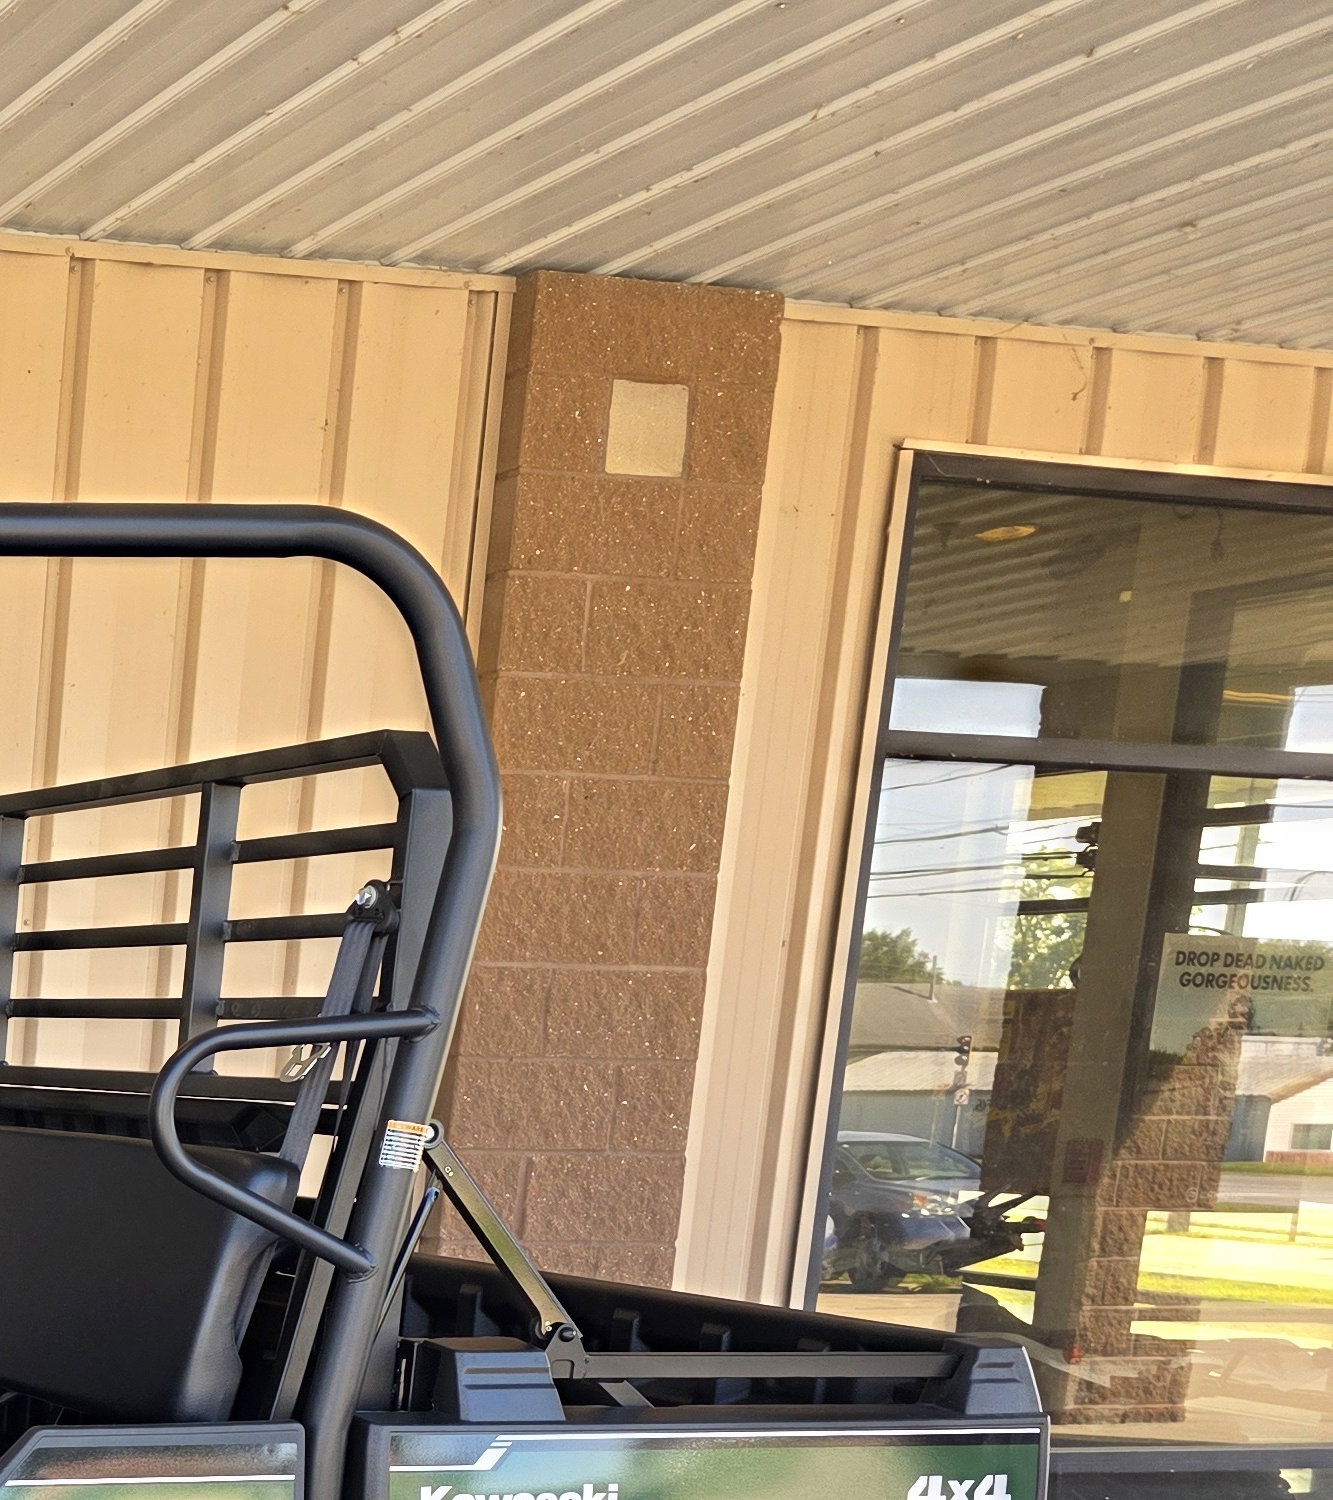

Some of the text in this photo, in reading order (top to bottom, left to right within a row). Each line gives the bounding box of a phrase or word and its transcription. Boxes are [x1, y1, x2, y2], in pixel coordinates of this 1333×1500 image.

[1175, 950, 1325, 972] DROP DEAD NAKED
[1179, 971, 1314, 993] GORGEOUSNESS.
